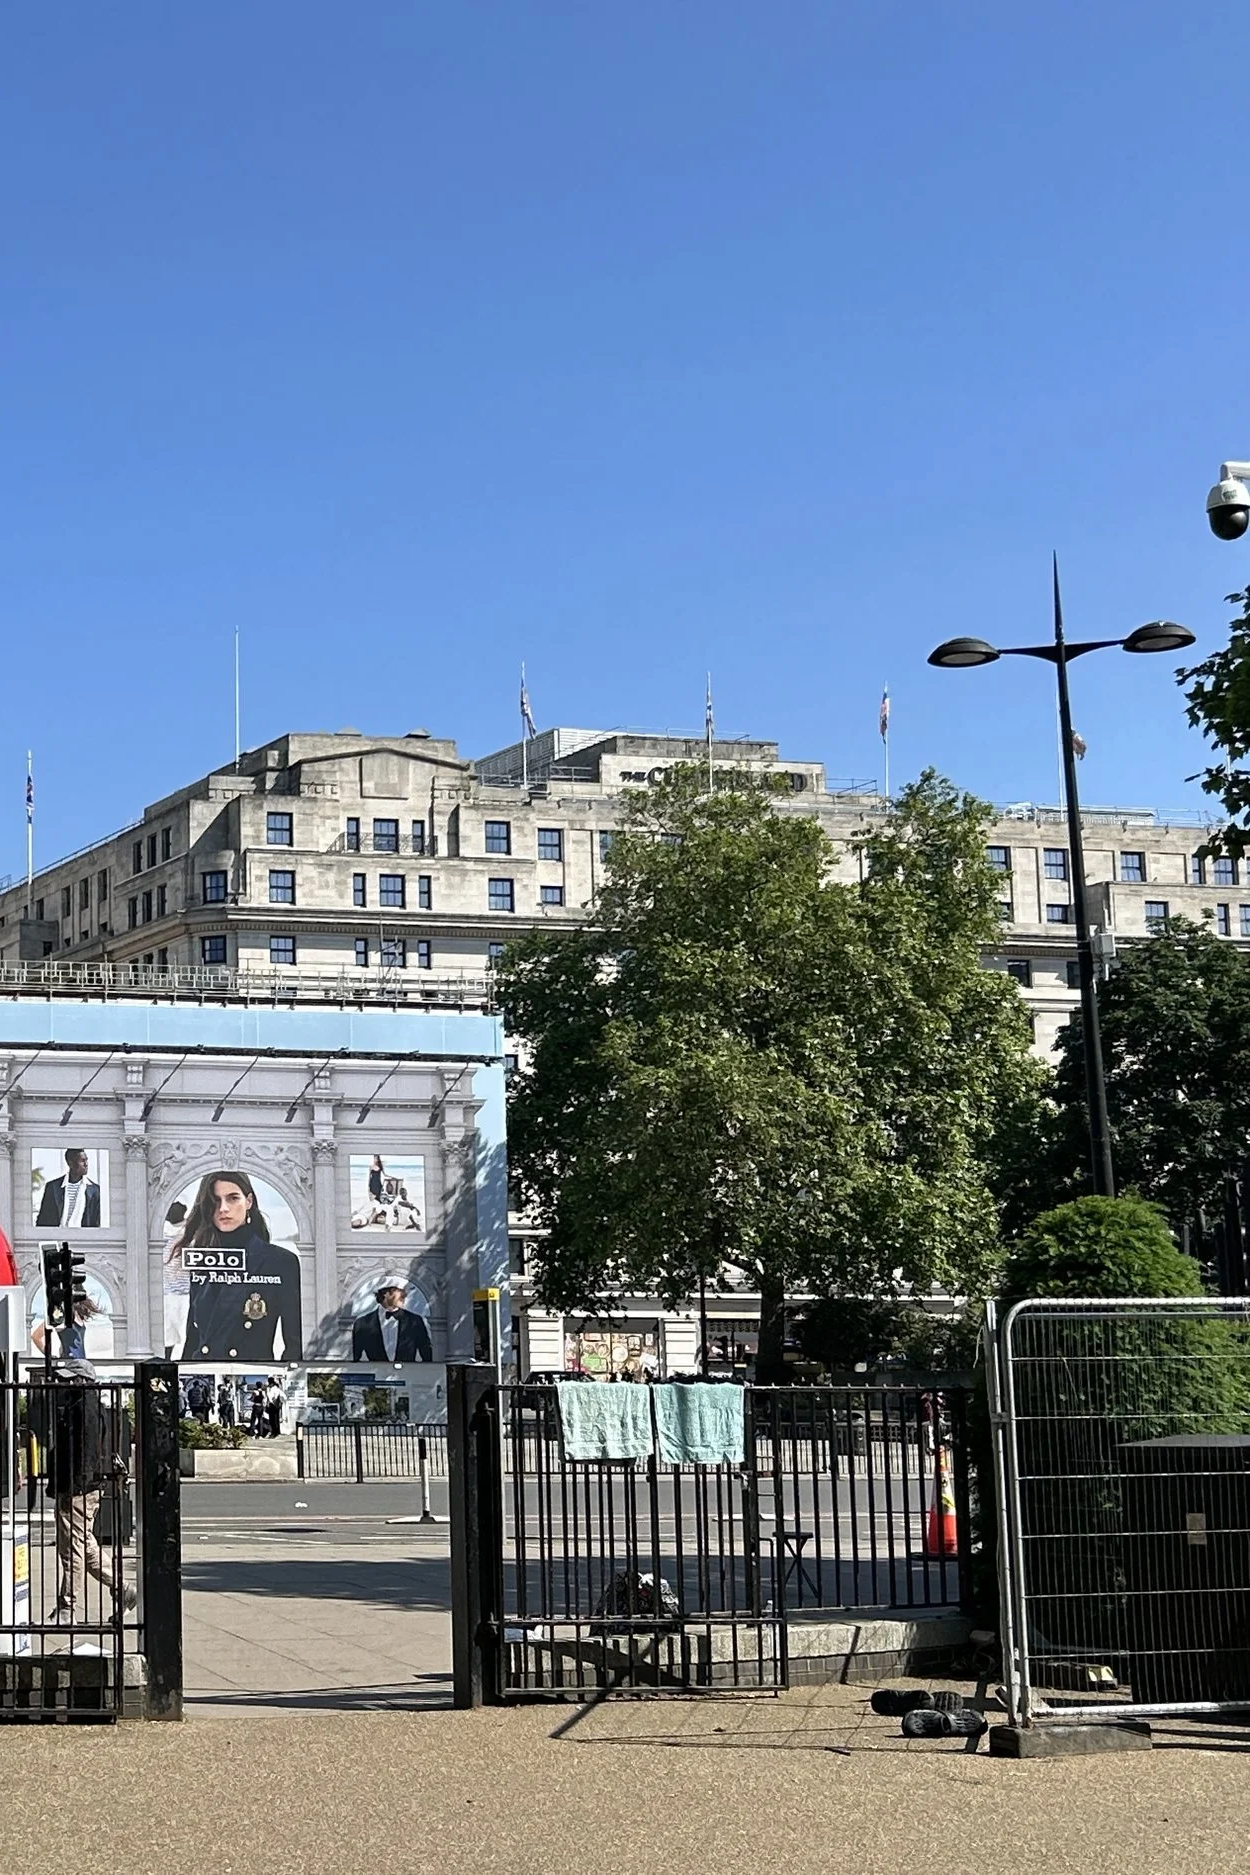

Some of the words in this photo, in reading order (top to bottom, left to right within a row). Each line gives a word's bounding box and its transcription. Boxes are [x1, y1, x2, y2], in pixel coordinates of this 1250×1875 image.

[186, 1252, 240, 1267] Polo
[191, 1271, 207, 1285] by
[208, 1271, 241, 1285] Ralph
[243, 1272, 282, 1284] Lauren
